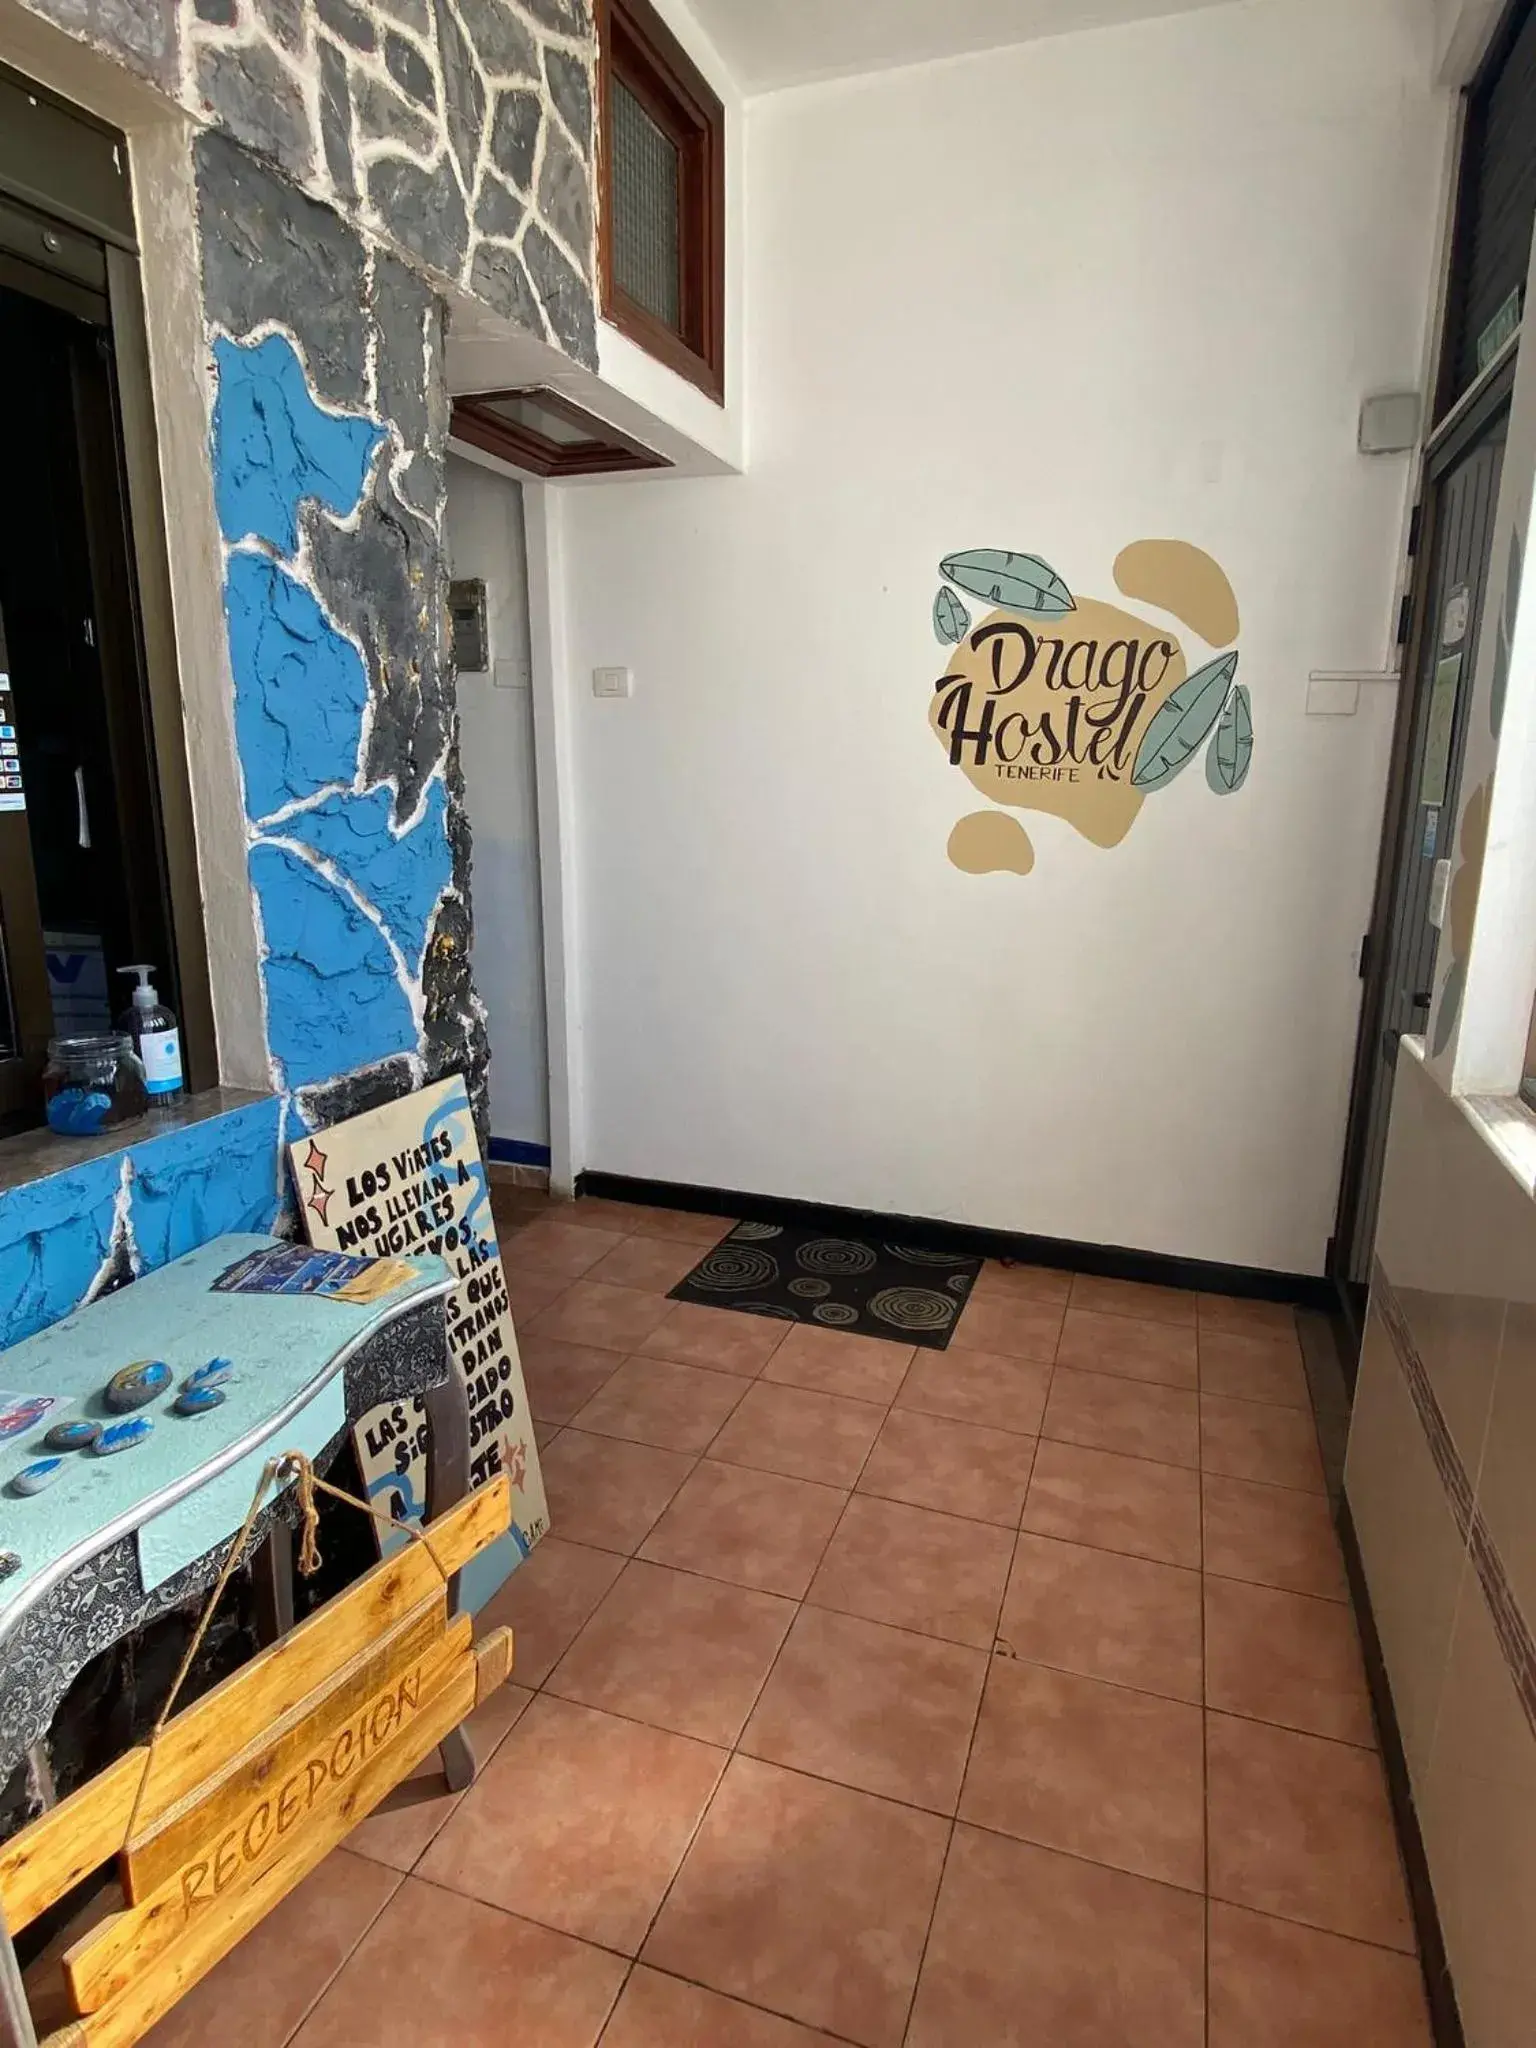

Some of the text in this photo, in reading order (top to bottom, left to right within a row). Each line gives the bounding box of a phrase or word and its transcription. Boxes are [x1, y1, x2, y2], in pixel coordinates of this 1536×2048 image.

[970, 621, 1179, 728] Drago
[935, 674, 1147, 771] Hostel
[994, 763, 1081, 783] TENERIFE
[335, 1159, 471, 1251] NOS LLEVAN A
[346, 1162, 391, 1208] LOS
[360, 1194, 455, 1257] UGARES
[456, 1239, 490, 1280] LAS
[467, 1265, 502, 1304] QUE
[365, 1326, 503, 1458] LAS DAN
[180, 1666, 422, 1922] RECEPCION
